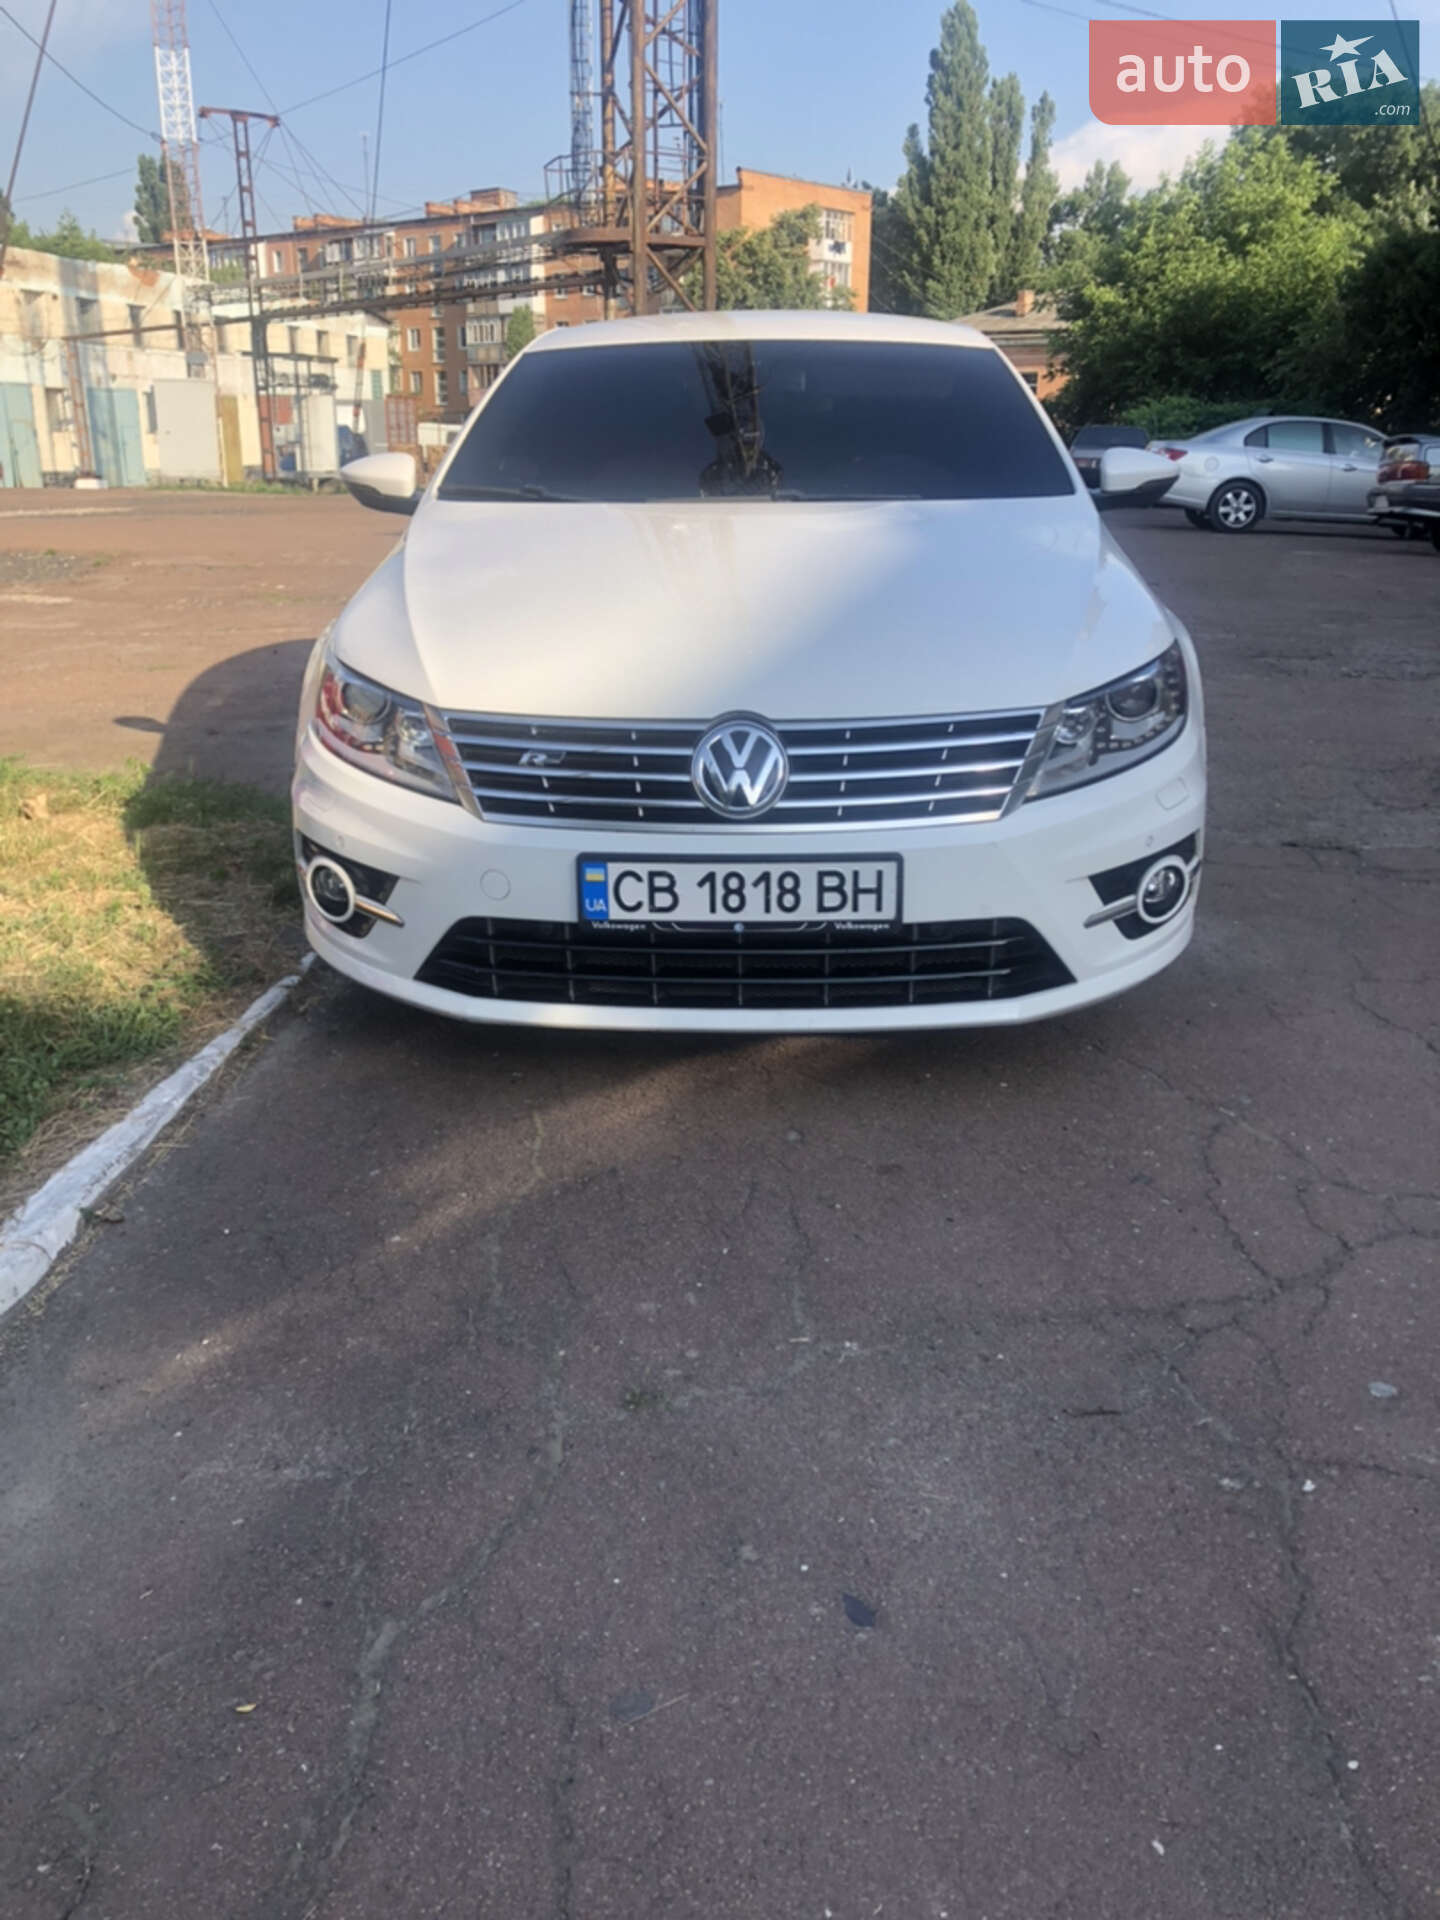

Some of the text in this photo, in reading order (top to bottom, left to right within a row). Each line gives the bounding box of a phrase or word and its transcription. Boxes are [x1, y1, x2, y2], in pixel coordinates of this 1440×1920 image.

[585, 898, 607, 912] UA
[613, 869, 883, 914] CB 1818 BH
